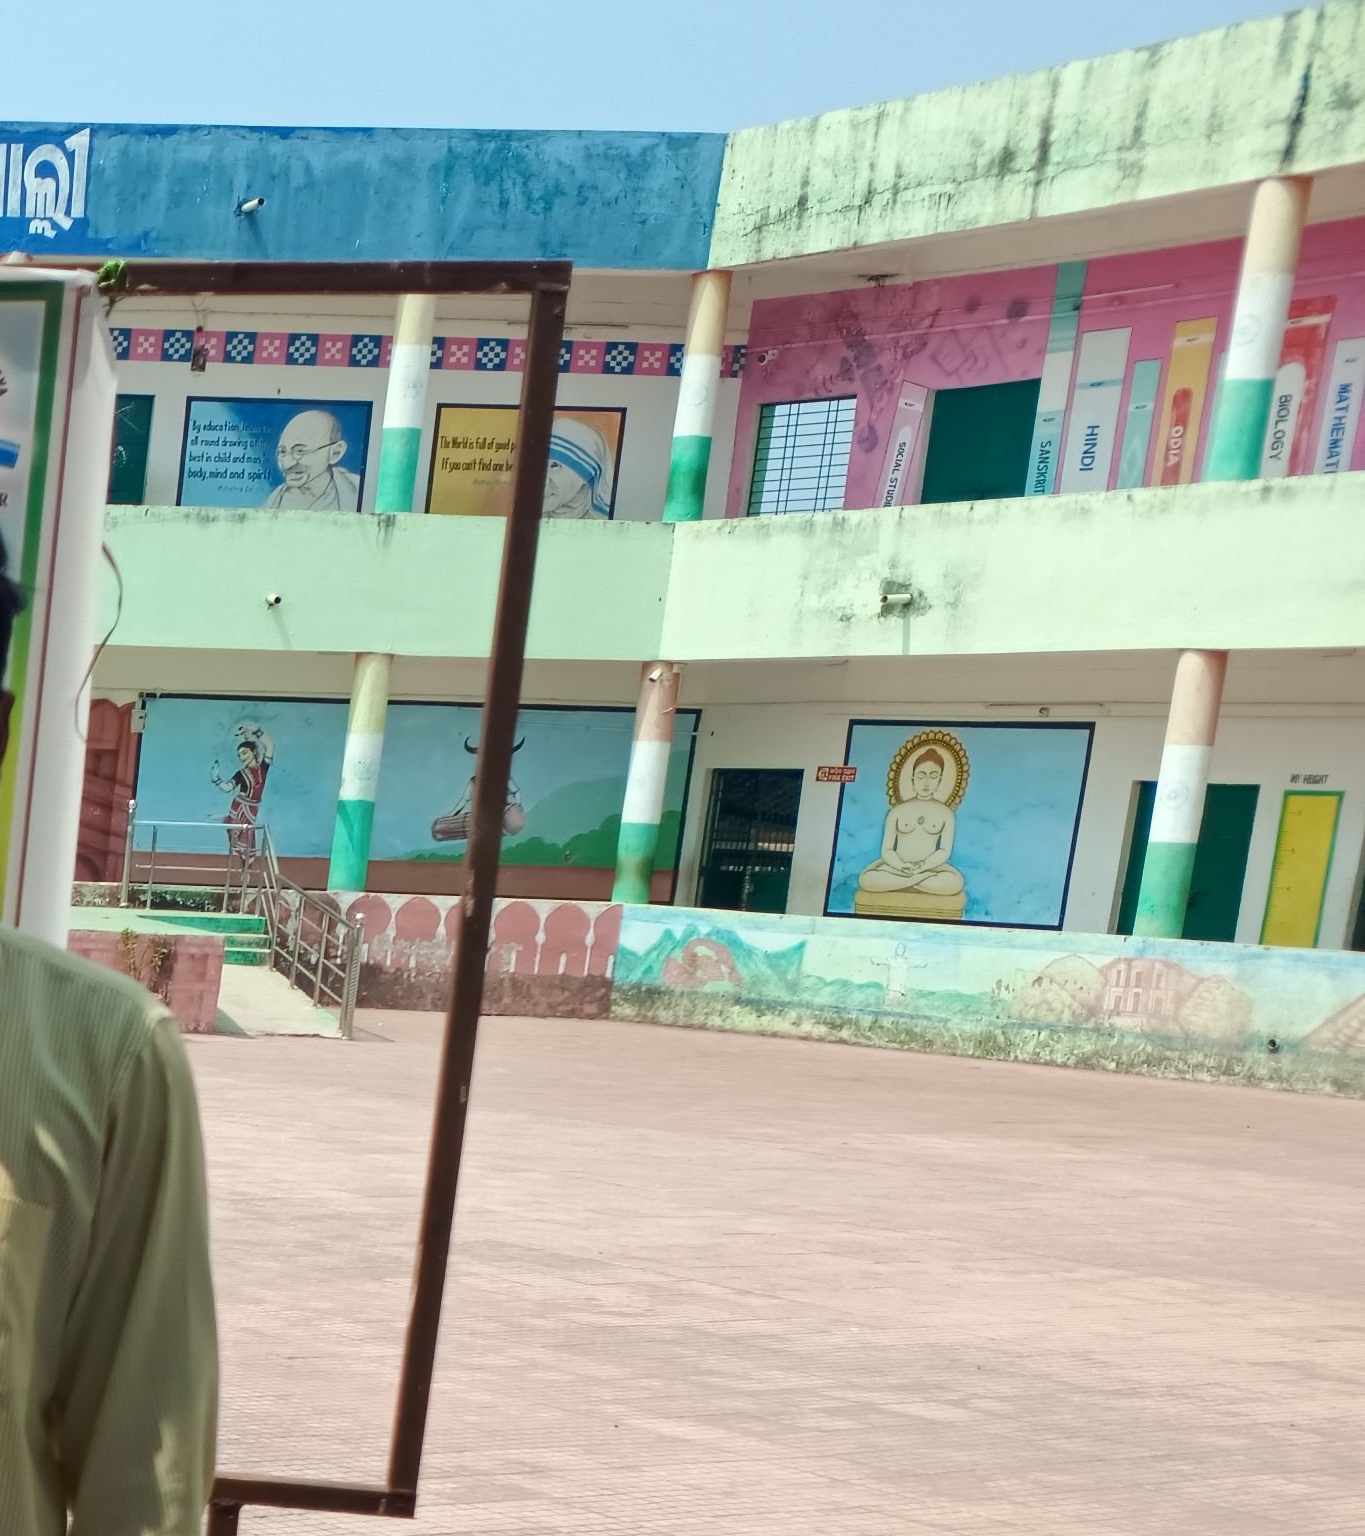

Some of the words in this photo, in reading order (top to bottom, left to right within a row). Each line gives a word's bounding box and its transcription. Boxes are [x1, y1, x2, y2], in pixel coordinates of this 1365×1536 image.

[1269, 394, 1292, 461] BIOLOGY
[1325, 383, 1354, 474] MATHEMATI
[214, 452, 231, 462] child
[478, 458, 492, 471] find
[891, 442, 907, 475] SOCIAL
[1079, 425, 1100, 471] HINDI
[229, 468, 245, 479] and
